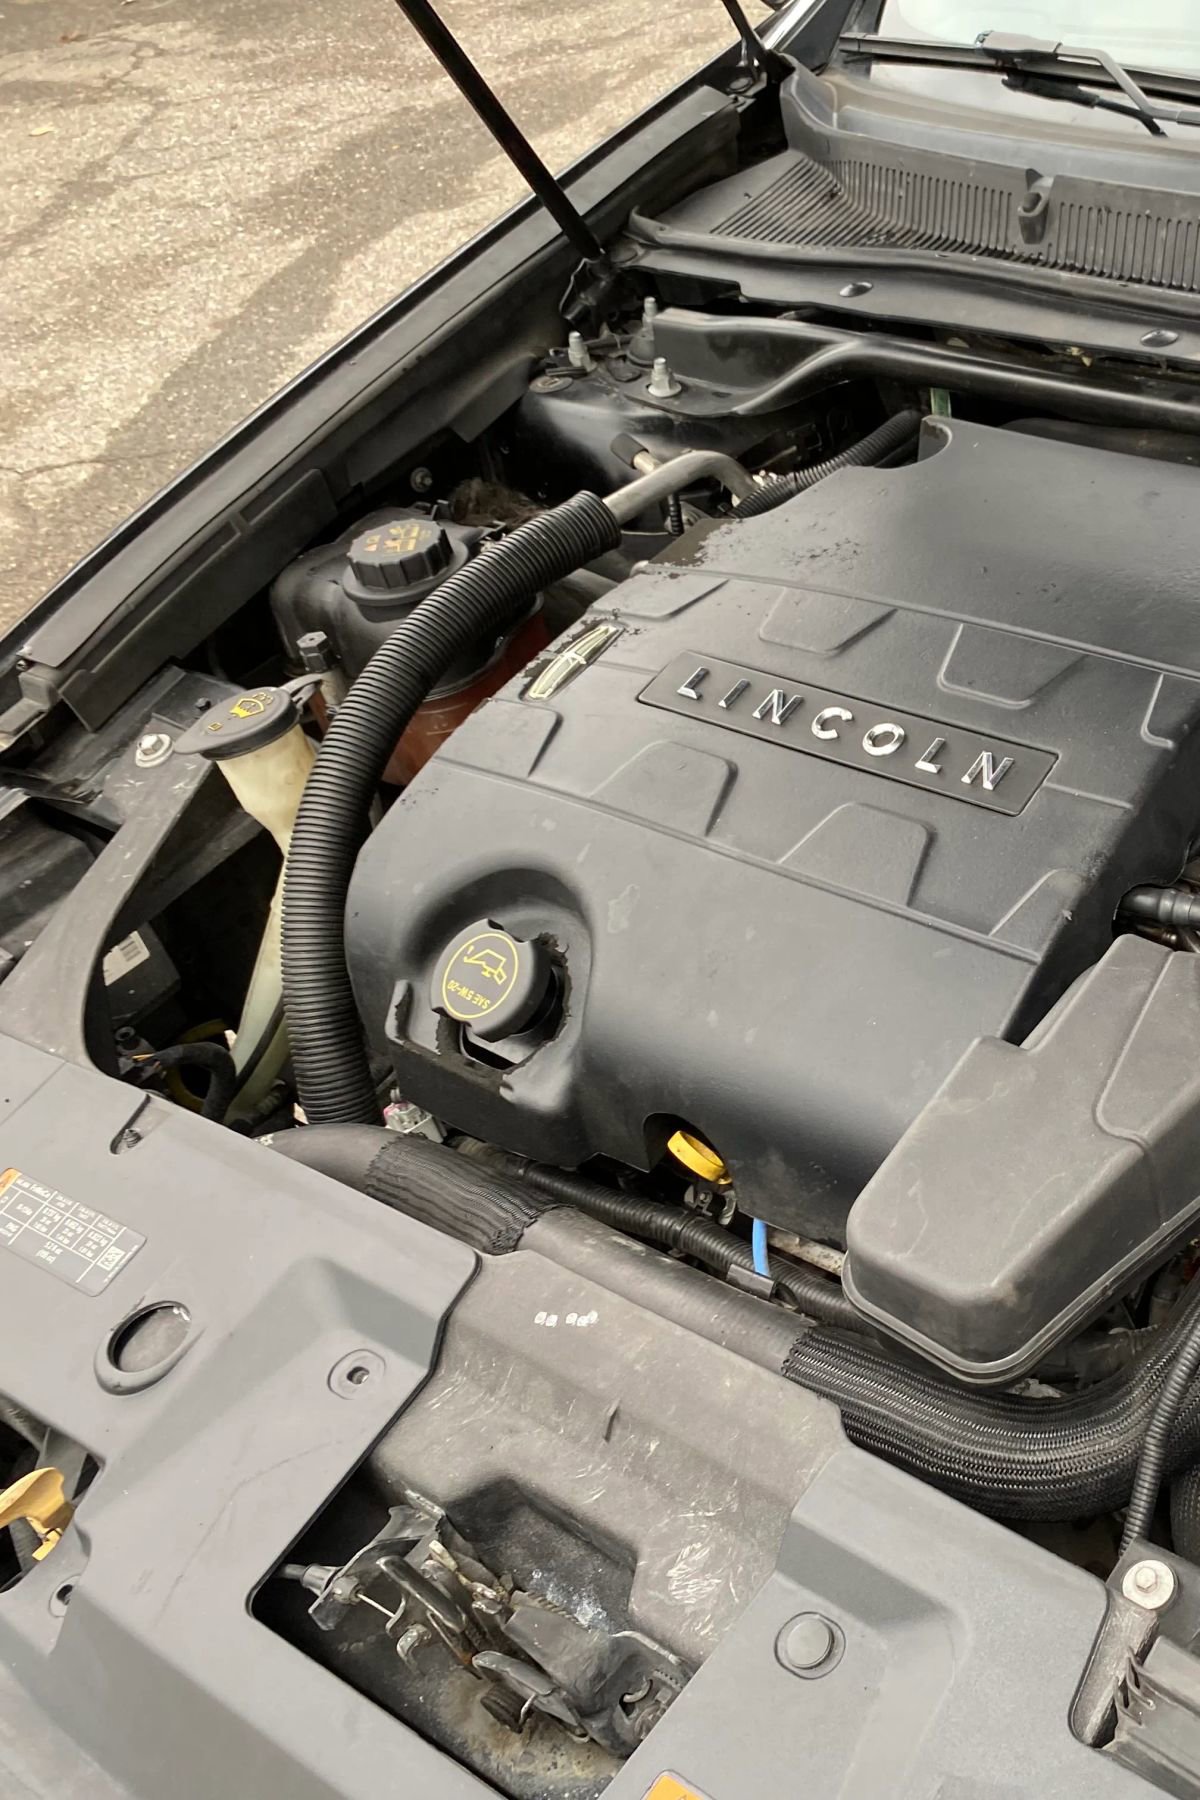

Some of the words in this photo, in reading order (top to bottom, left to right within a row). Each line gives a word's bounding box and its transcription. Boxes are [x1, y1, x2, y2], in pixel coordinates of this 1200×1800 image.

[676, 666, 1015, 791] LINCOLN
[447, 979, 473, 1001] 5W-20
[472, 994, 491, 1010] SAE
